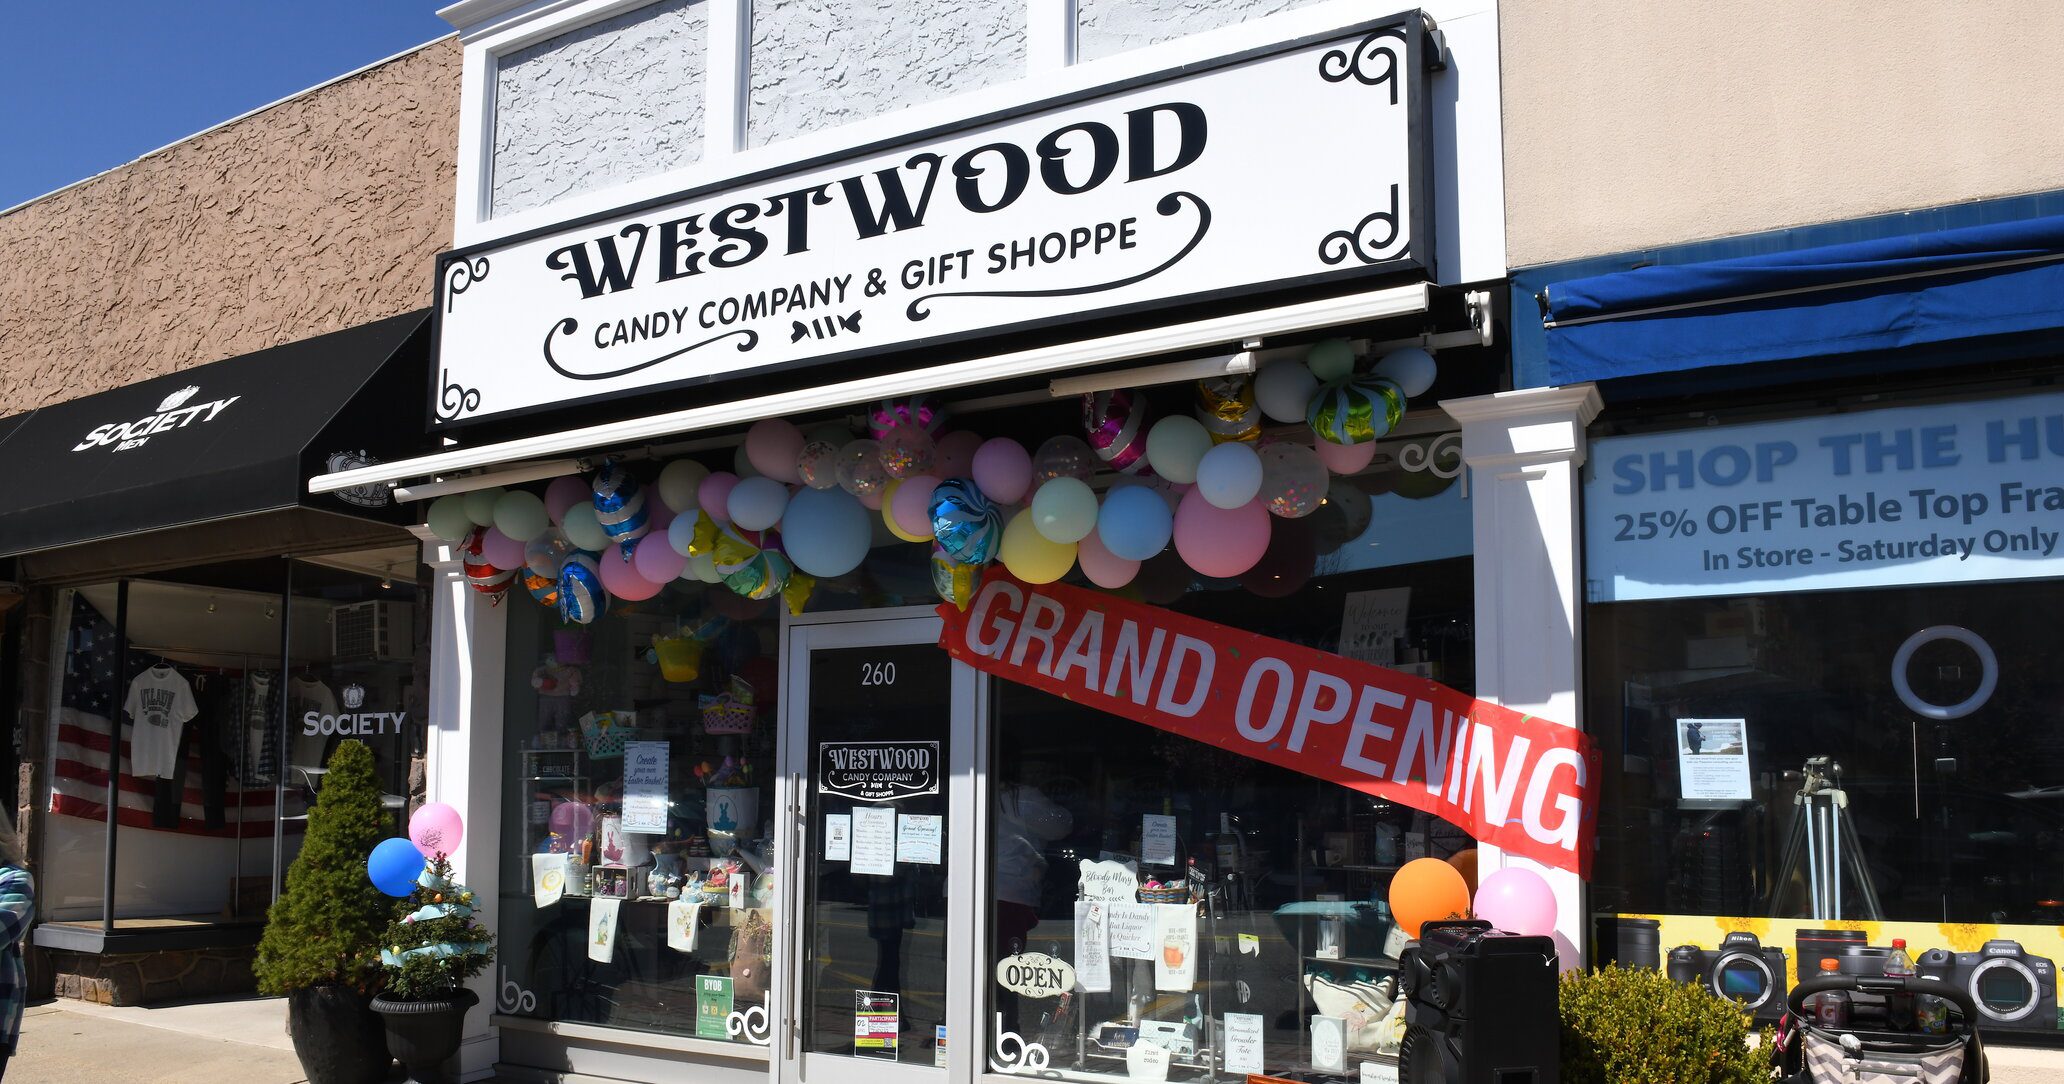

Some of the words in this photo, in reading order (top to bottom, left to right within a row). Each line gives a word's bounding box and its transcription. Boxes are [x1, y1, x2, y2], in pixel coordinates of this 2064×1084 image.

[545, 102, 1208, 300] WESTWOOD
[594, 306, 689, 349] CANDY
[698, 273, 853, 329] COMPANY
[864, 267, 887, 297] &
[901, 248, 975, 290] GIFT
[987, 216, 1138, 274] SHOPPE
[72, 395, 242, 452] SOCIETY
[112, 436, 151, 453] MEN
[1612, 440, 1799, 495] SHOP
[1818, 423, 1962, 476] THE
[1614, 508, 1698, 542] 25%
[1706, 500, 1784, 535] OFF
[1790, 491, 1903, 529] Table
[1908, 488, 1989, 525] Top
[1703, 549, 1730, 571] In
[1736, 546, 1814, 570] Store
[1837, 533, 1977, 562] Saturday
[1983, 526, 2059, 557] Only
[861, 662, 896, 686] 260
[303, 711, 407, 737] SOCIETY
[964, 579, 1217, 718] GRAND
[1234, 656, 1587, 851] OPENING
[828, 747, 930, 770] WESTWOOD
[842, 773, 871, 782] CANDY
[872, 773, 914, 782] COMPANY
[865, 790, 875, 798] GIFT
[875, 789, 894, 798] SHOPPE
[1085, 870, 1112, 885] Bloody
[1112, 872, 1133, 886] Mary
[1102, 884, 1115, 896] Bar
[1121, 922, 1143, 932] Liquor
[1128, 911, 1151, 922] Dandy
[1989, 947, 2017, 955] Canon
[704, 979, 722, 991] BYOB
[1005, 963, 1065, 989] OPEN
[1236, 1045, 1252, 1054] Tote
